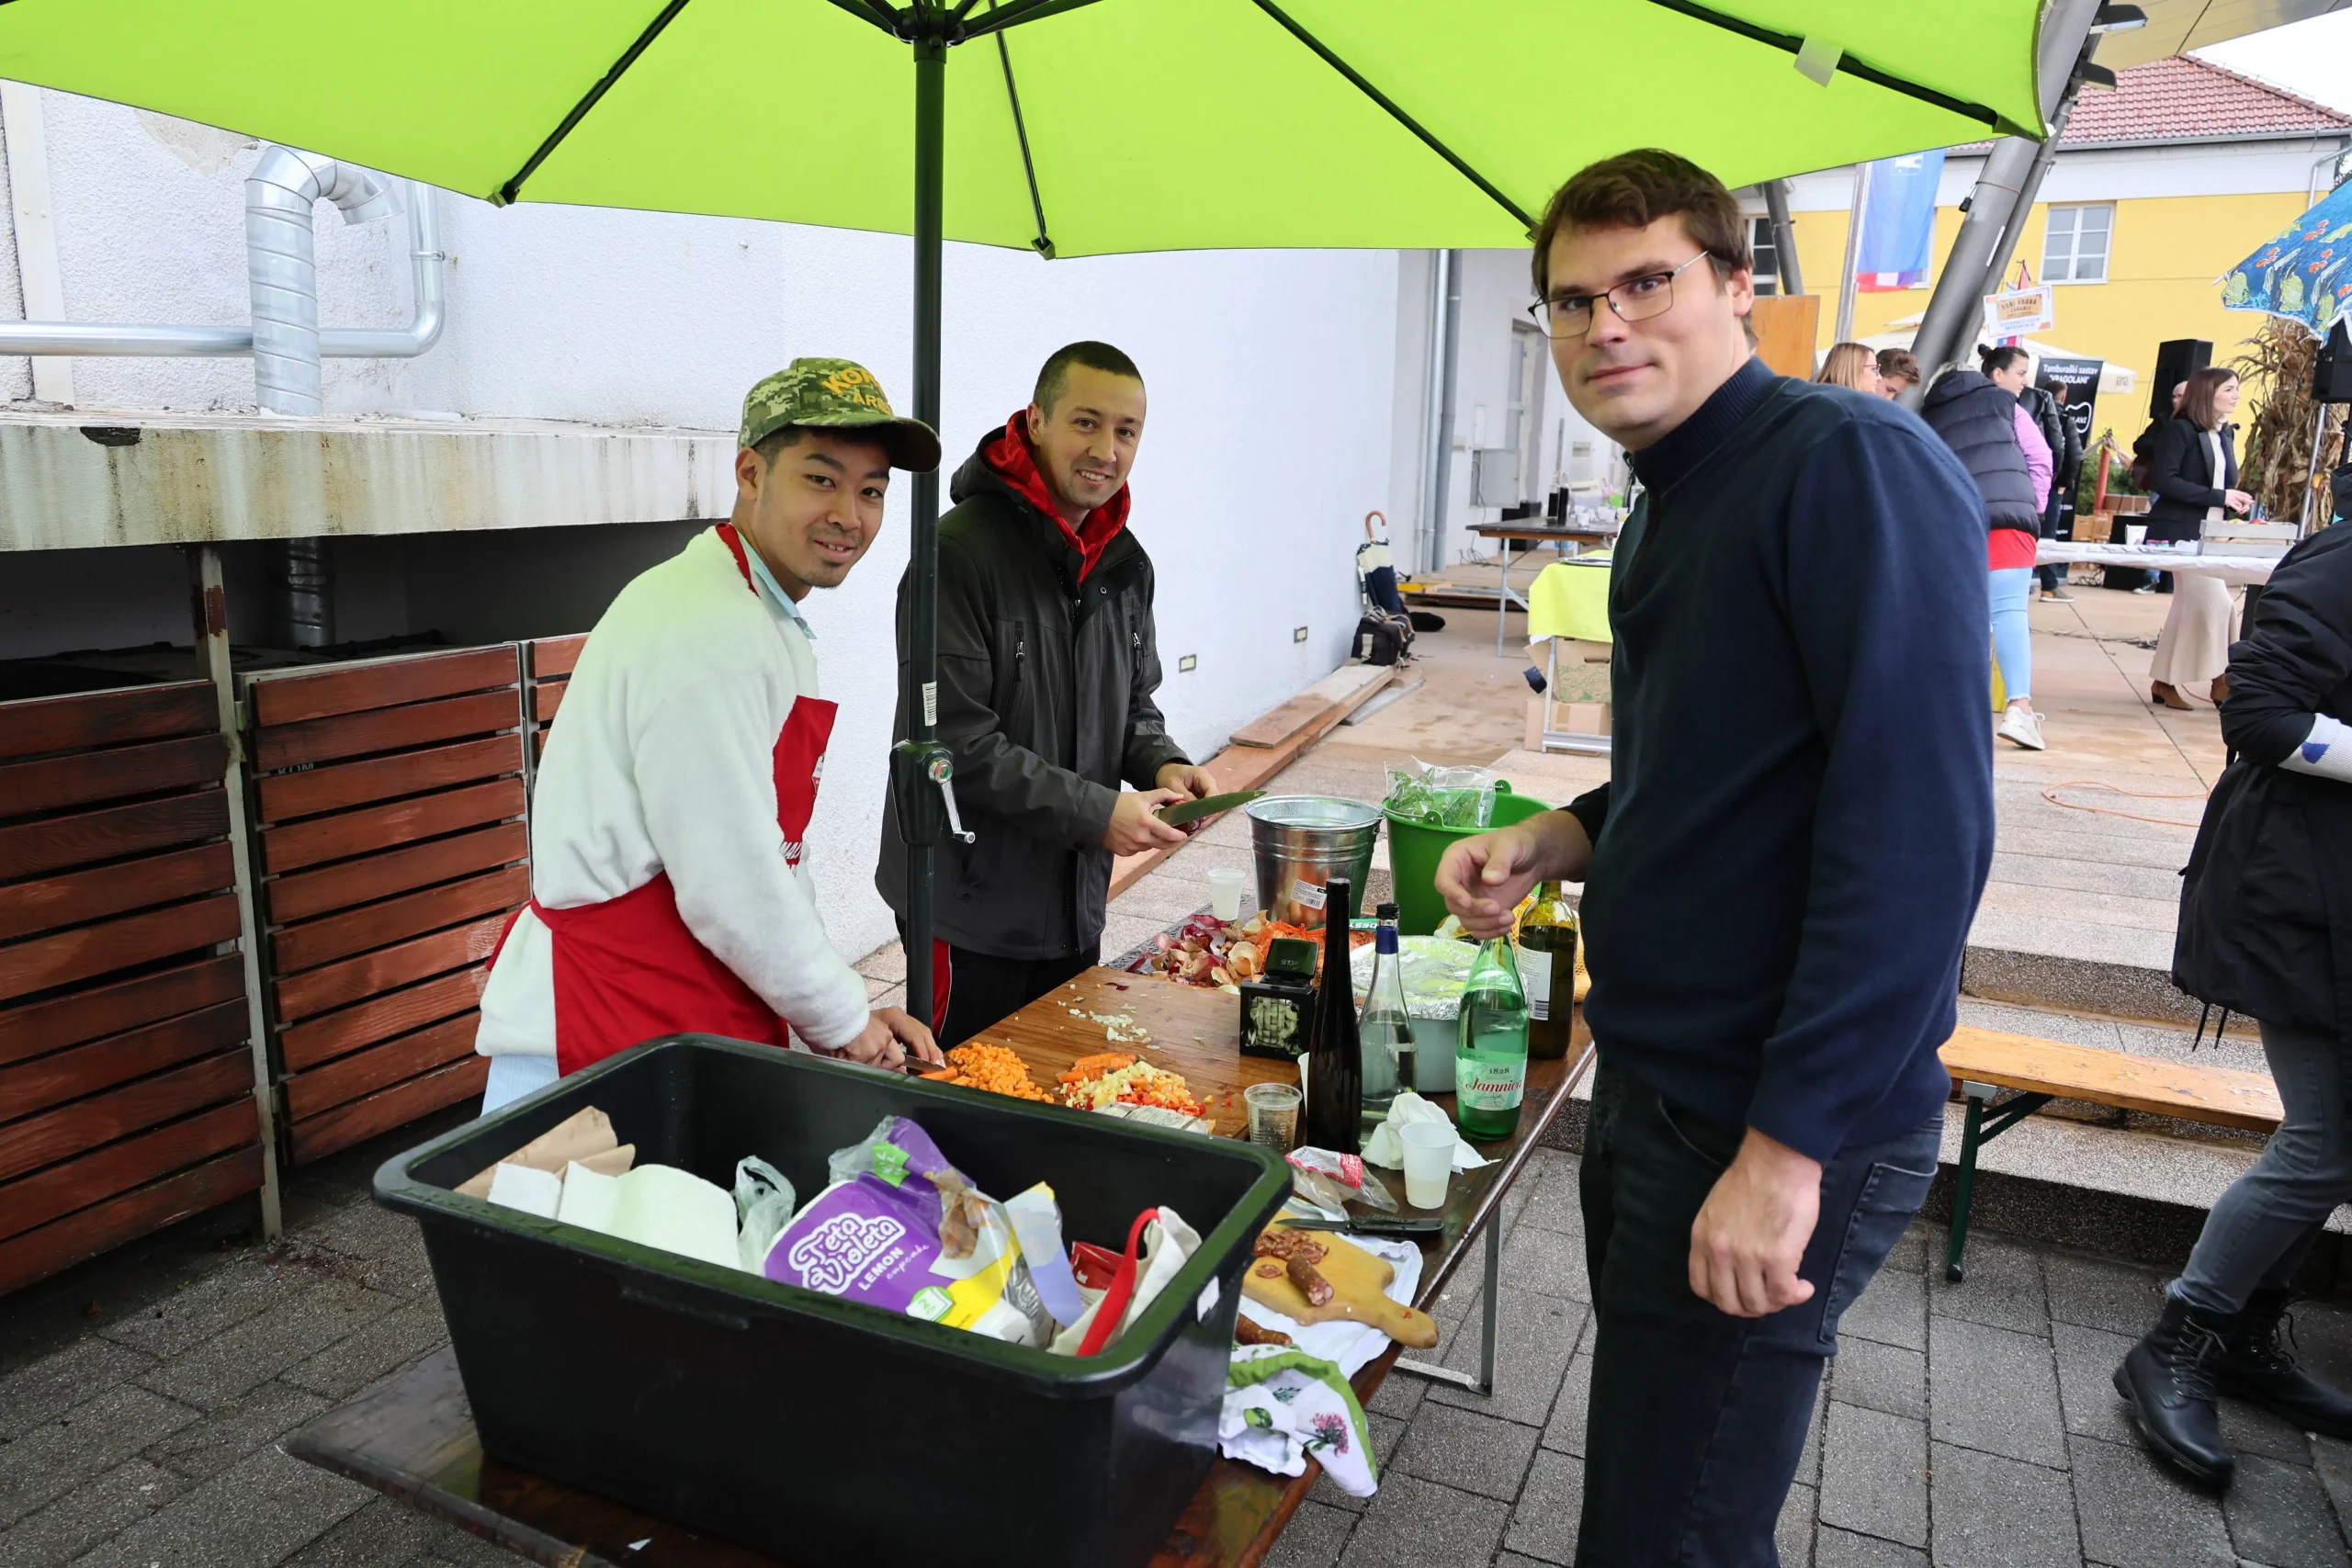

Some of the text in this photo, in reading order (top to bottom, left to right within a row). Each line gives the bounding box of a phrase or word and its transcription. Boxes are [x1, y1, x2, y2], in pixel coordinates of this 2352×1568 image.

[821, 368, 880, 395] KOR
[1465, 1076, 1522, 1092] Jamnica
[796, 1220, 860, 1265] Teta
[810, 1220, 898, 1285] Violeta
[887, 1243, 930, 1280] cupcake
[858, 1247, 904, 1291] LEMON
